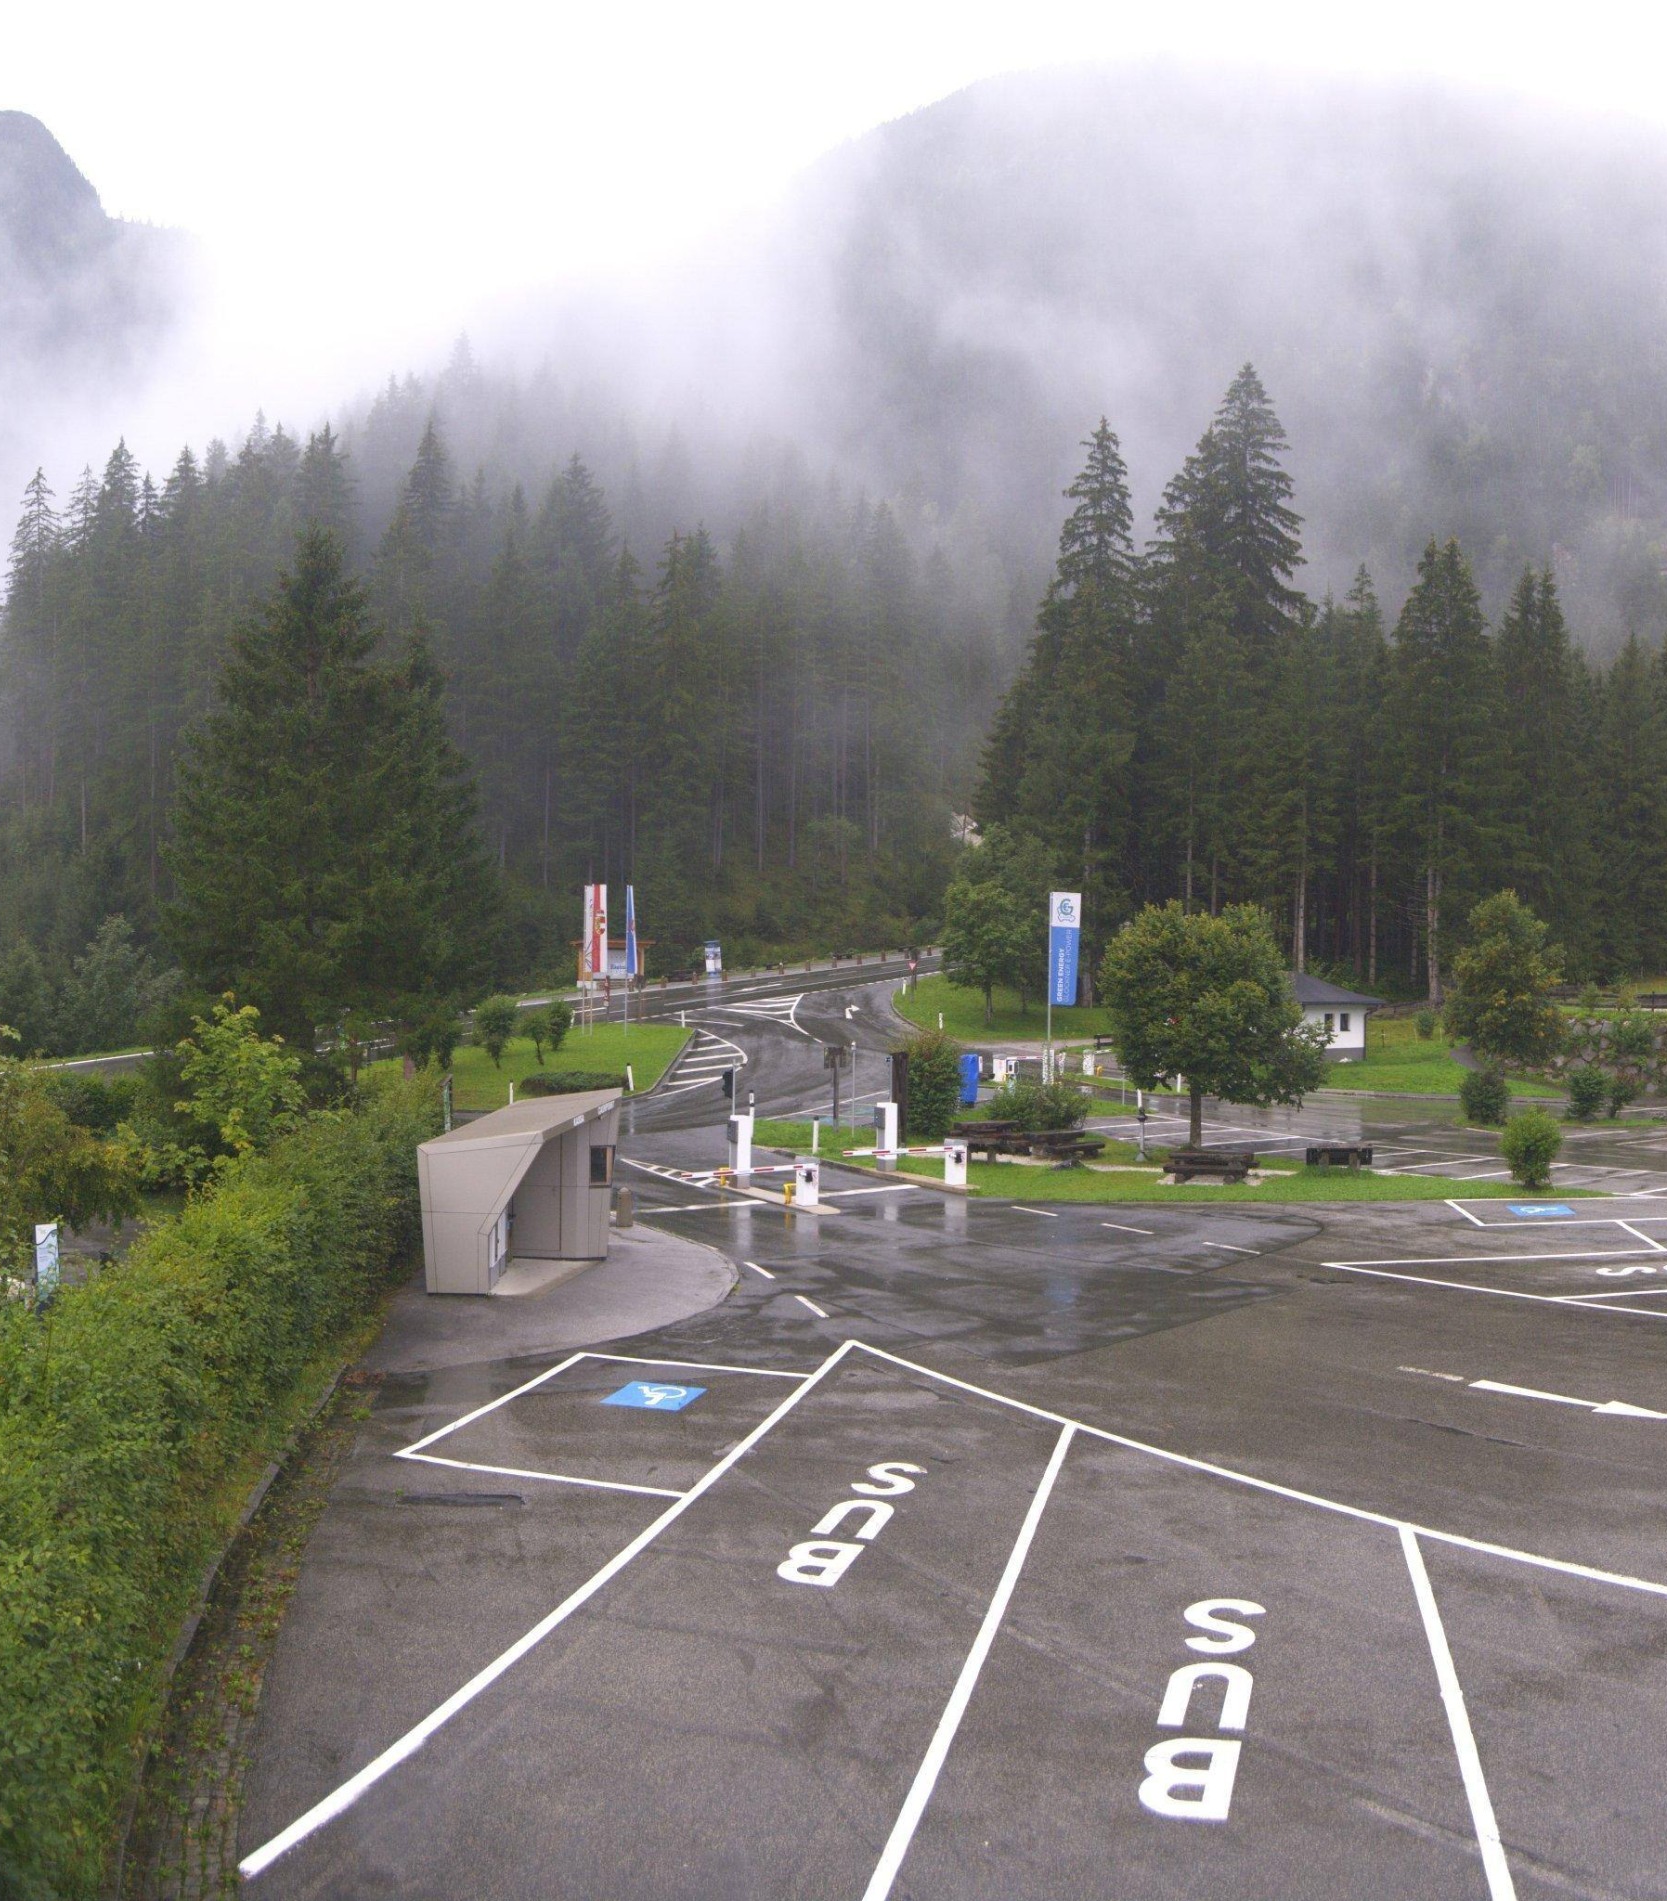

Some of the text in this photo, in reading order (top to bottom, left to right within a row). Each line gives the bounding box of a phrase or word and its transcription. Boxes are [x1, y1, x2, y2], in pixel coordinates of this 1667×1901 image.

[1056, 979, 1064, 1003] GREEN
[776, 1462, 928, 1587] BUS
[1138, 1598, 1267, 1821] BUS
